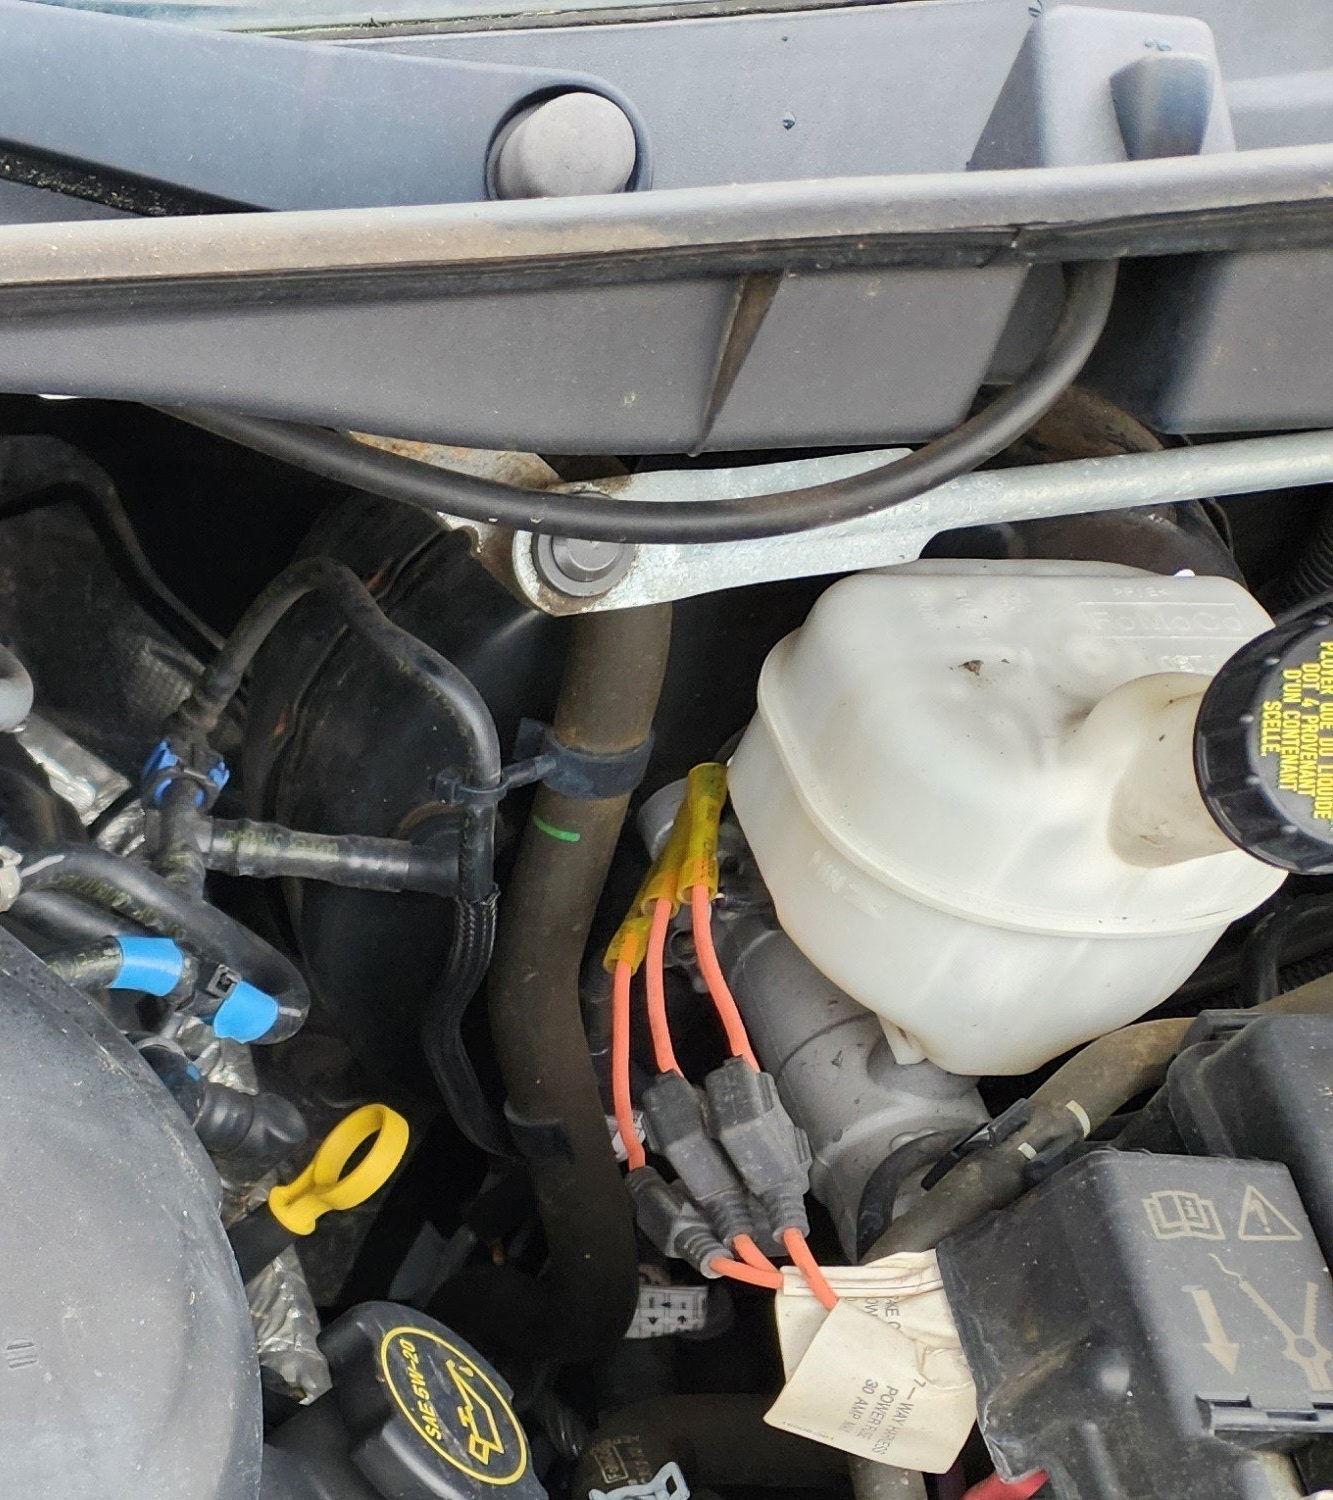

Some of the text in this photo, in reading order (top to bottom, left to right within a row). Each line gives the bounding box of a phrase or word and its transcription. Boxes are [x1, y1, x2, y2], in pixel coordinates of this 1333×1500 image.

[1278, 668, 1302, 792] D'UN CONTENANT
[1298, 661, 1321, 797] DOT 4 PROVENANT
[399, 1338, 442, 1441] SAE 5W-20
[848, 1396, 869, 1420] AMP
[861, 1378, 879, 1395] 30
[867, 1385, 899, 1426] POWER
